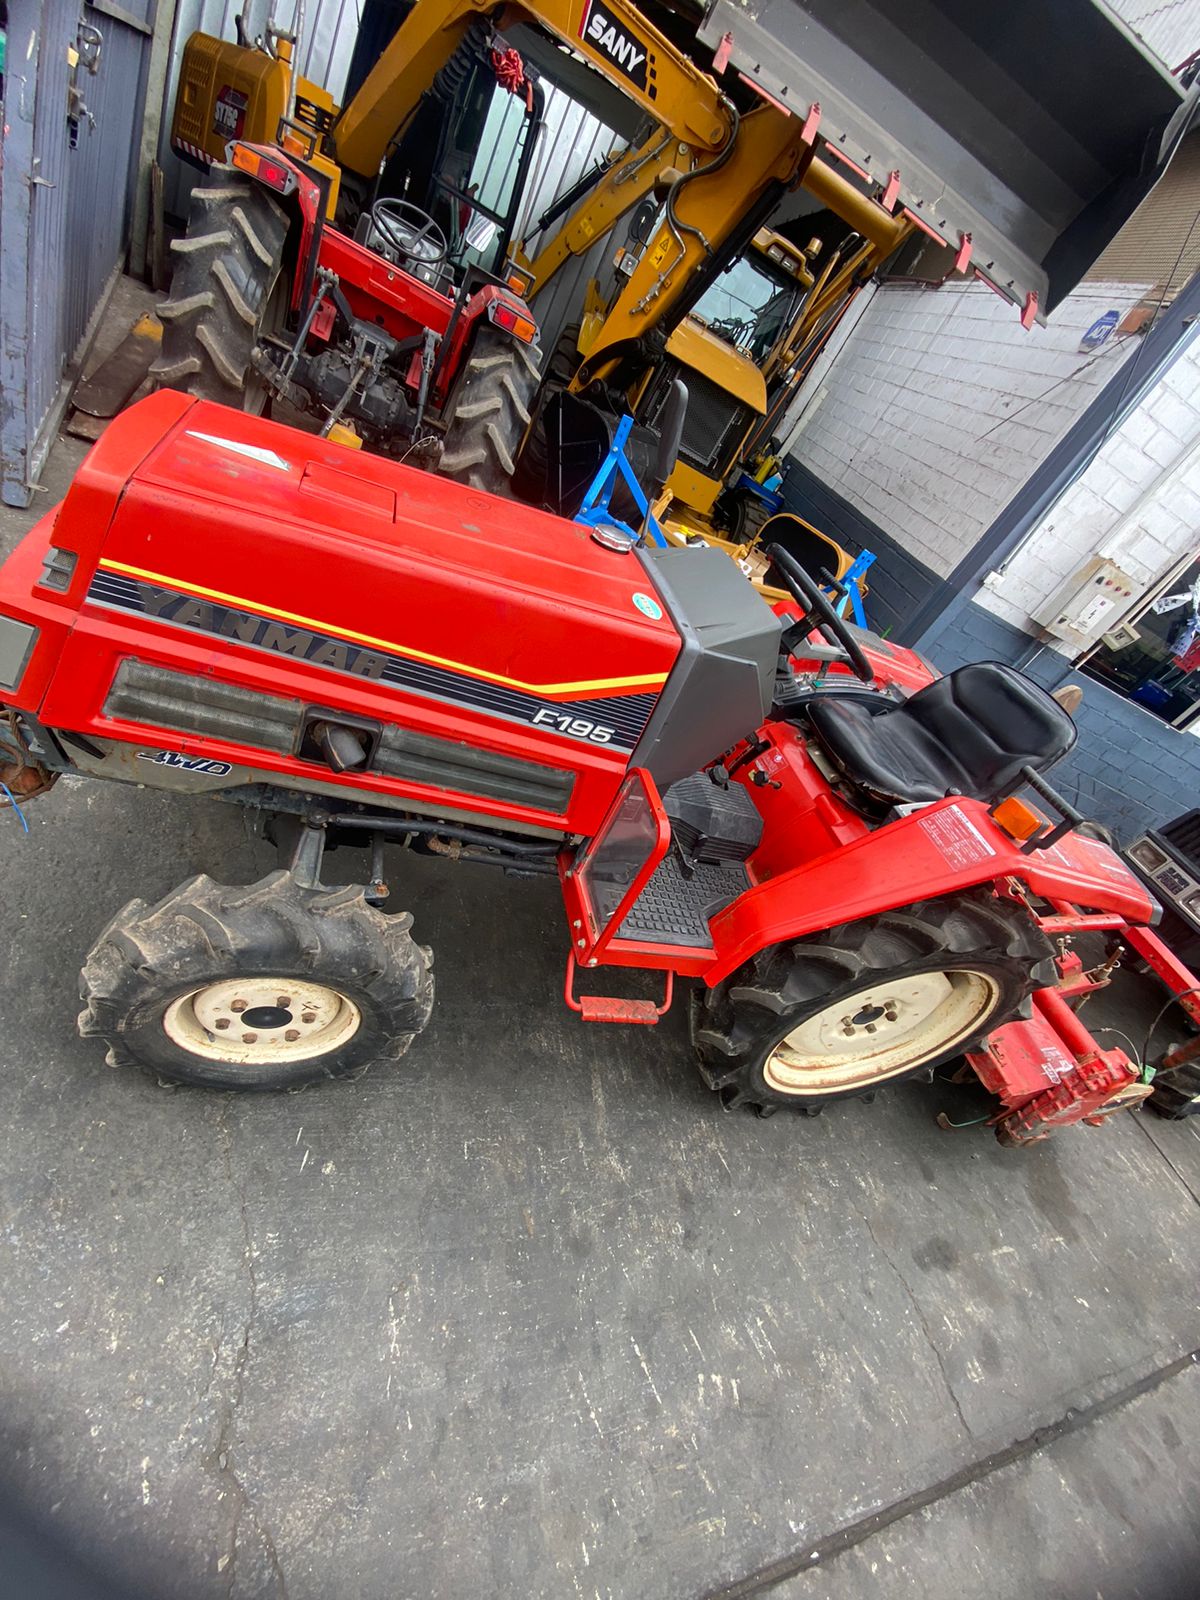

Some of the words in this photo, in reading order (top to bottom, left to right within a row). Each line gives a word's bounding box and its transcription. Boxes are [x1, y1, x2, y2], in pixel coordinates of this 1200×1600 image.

[587, 13, 646, 73] SANY
[136, 582, 388, 680] YANMAR
[532, 708, 616, 743] F195
[137, 750, 233, 777] 4WD
